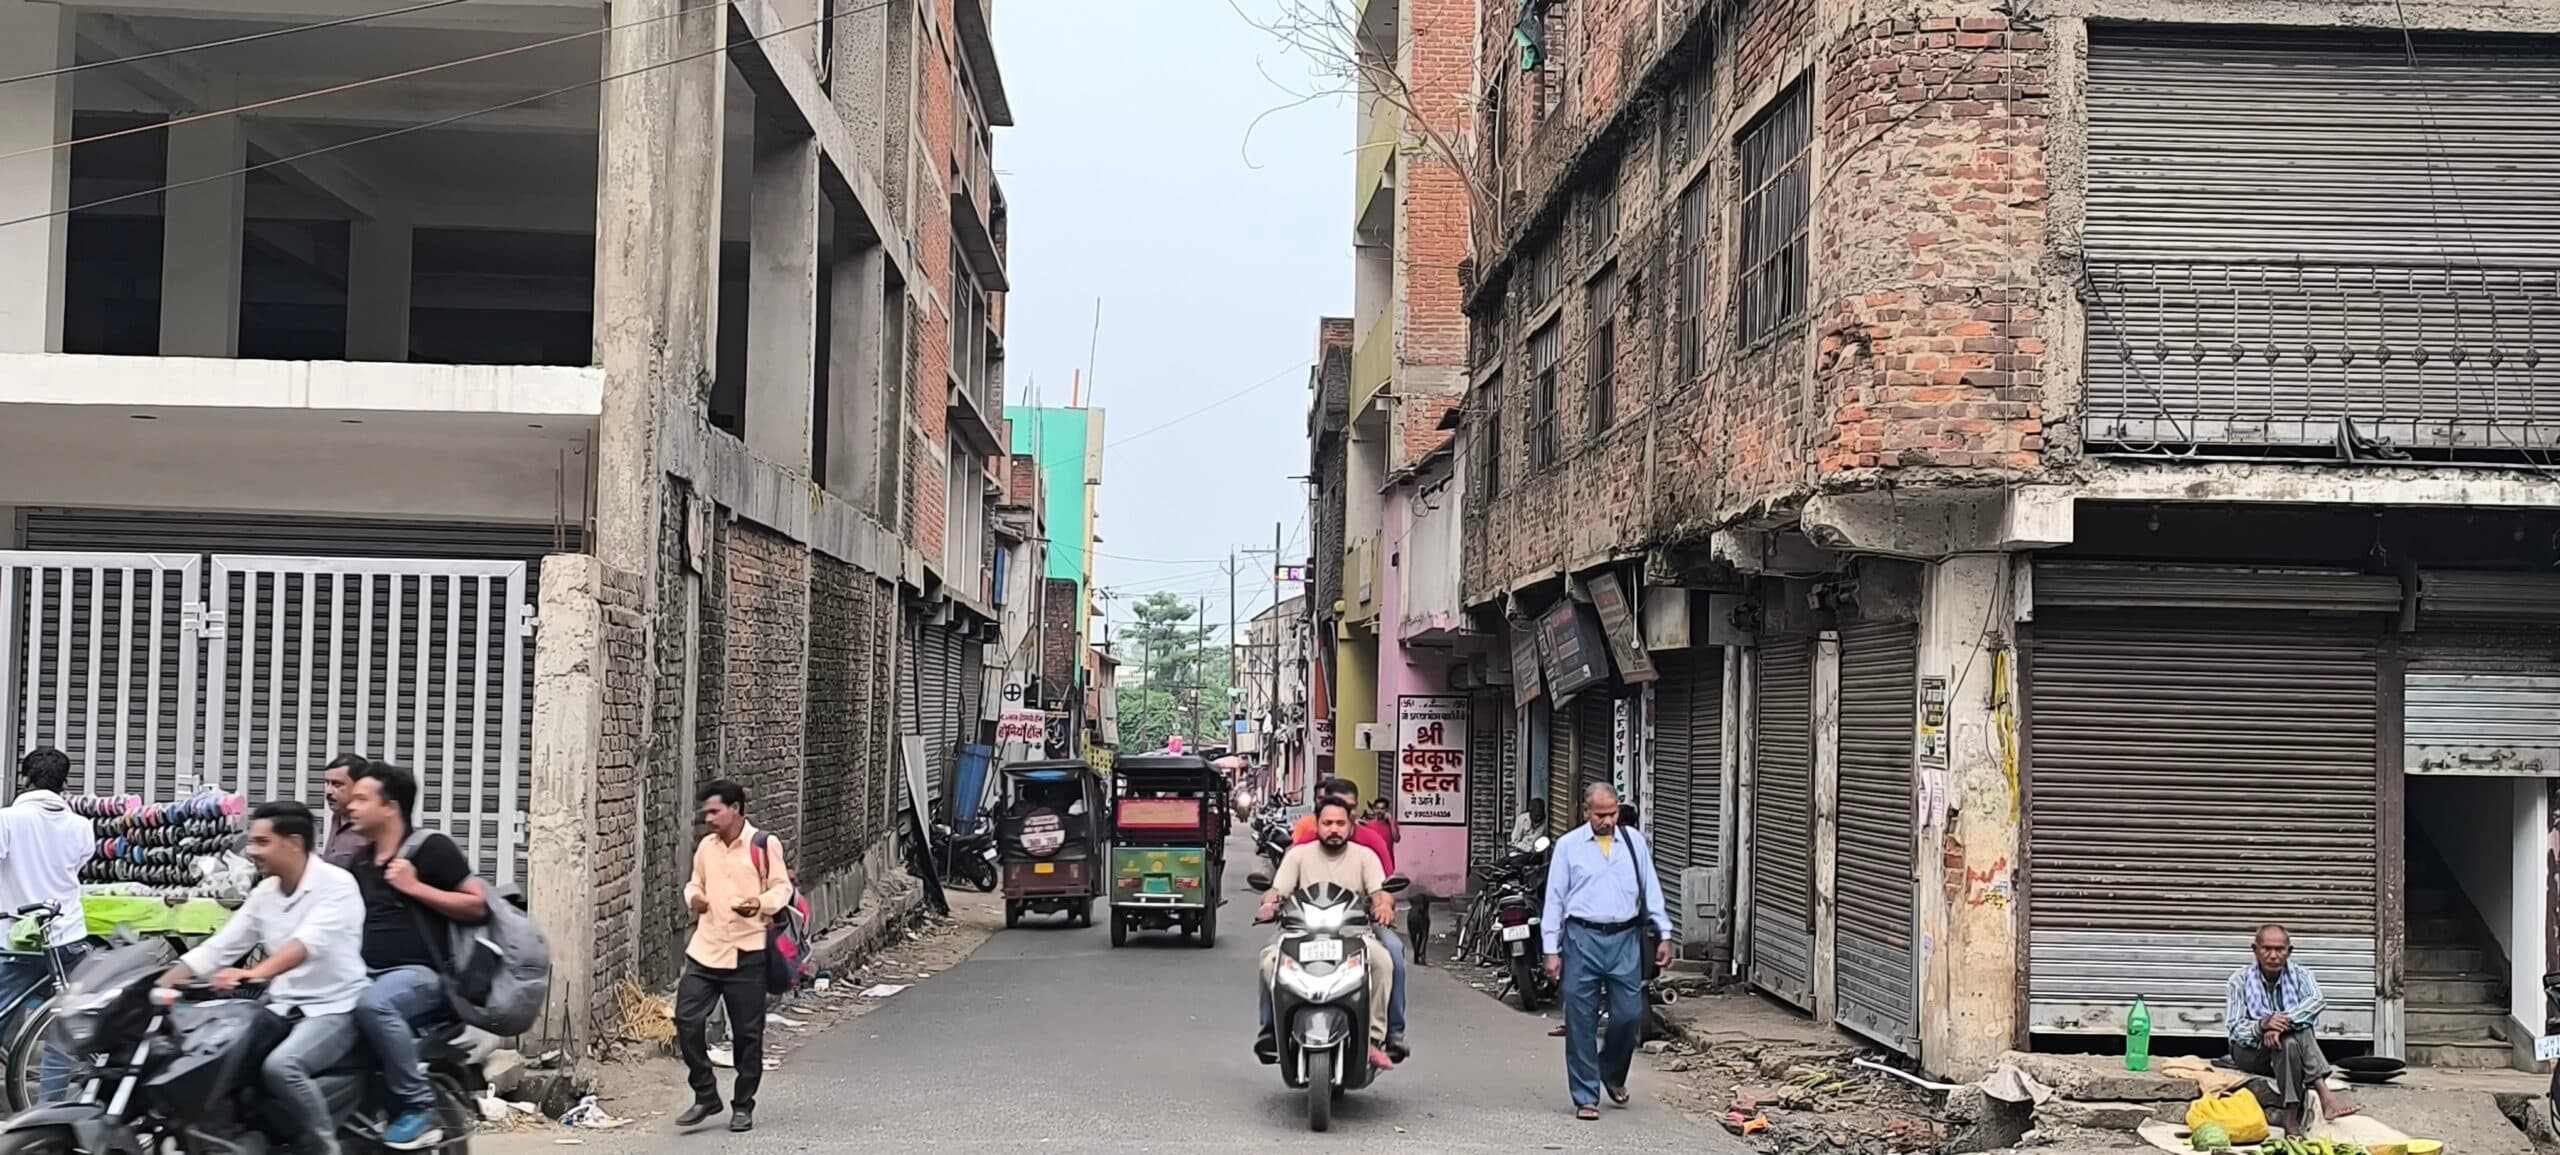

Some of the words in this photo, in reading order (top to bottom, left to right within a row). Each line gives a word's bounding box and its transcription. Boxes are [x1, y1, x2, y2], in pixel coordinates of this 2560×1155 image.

[1417, 721, 1444, 746] श्री
[1402, 744, 1464, 772] बेवकूफ
[1401, 768, 1462, 793] होटल
